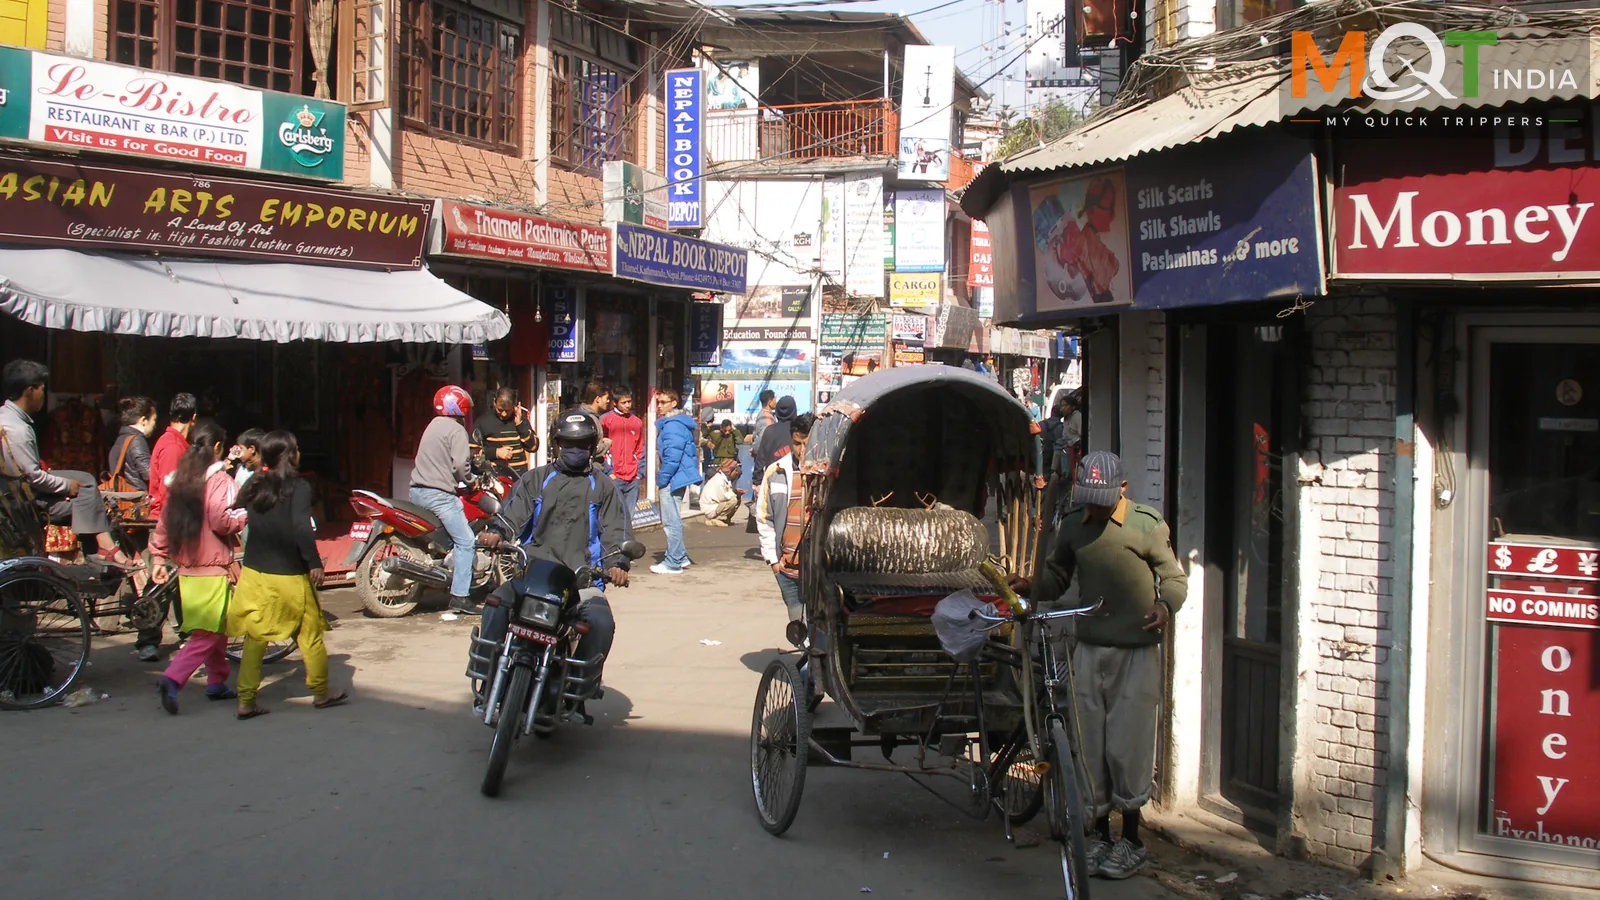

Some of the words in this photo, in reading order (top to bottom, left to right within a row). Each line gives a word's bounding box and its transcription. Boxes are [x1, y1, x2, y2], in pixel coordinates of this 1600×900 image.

[38, 63, 255, 124] Le-Bistro
[673, 77, 695, 133] NEPAL
[47, 106, 141, 131] RESTAURANT
[145, 123, 156, 134] &
[161, 123, 188, 138] BAR
[193, 127, 215, 143] (P.)
[220, 131, 247, 147] LTD.
[279, 122, 333, 152] Carlsberg
[1494, 104, 1600, 167] DE
[53, 128, 93, 145] Visit
[99, 137, 117, 148] us
[123, 138, 149, 152] for
[153, 143, 199, 158] Good
[204, 149, 243, 164] Food
[194, 179, 211, 189] 786
[673, 139, 694, 195] BOOK
[0, 172, 116, 208] ASIAN
[143, 187, 235, 219] ARTS
[259, 198, 418, 238] EMPORIUM
[669, 202, 699, 222] DEPOT
[1138, 187, 1165, 210] Silk
[1168, 178, 1214, 206] Scarfs
[67, 222, 143, 240] (Specialist
[147, 231, 162, 241] in:
[168, 231, 196, 247] High
[201, 233, 246, 248] Fashion
[251, 238, 293, 252] Leather
[295, 241, 354, 258] Garments)
[168, 216, 182, 228] A
[184, 218, 225, 232] Land
[228, 222, 247, 237] Of
[247, 223, 273, 236] Art
[475, 210, 522, 240] Thamel
[525, 219, 579, 249] Pashmina
[581, 228, 608, 253] Point
[793, 238, 811, 246] KGH
[1140, 217, 1167, 241] Silk
[1170, 210, 1222, 238] Shawls
[1347, 190, 1595, 262] Money
[628, 231, 670, 268] NEPAL
[672, 240, 707, 270] BOOK
[709, 249, 747, 278] DEPOT
[1142, 245, 1218, 272] Pashminas
[1255, 236, 1300, 259] more
[893, 281, 936, 290] CARGO
[553, 290, 568, 335] USED
[894, 323, 924, 333] MASSAGE
[723, 329, 760, 340] Education
[1494, 545, 1512, 570] $
[1526, 548, 1559, 573] £
[1488, 597, 1517, 613] NO
